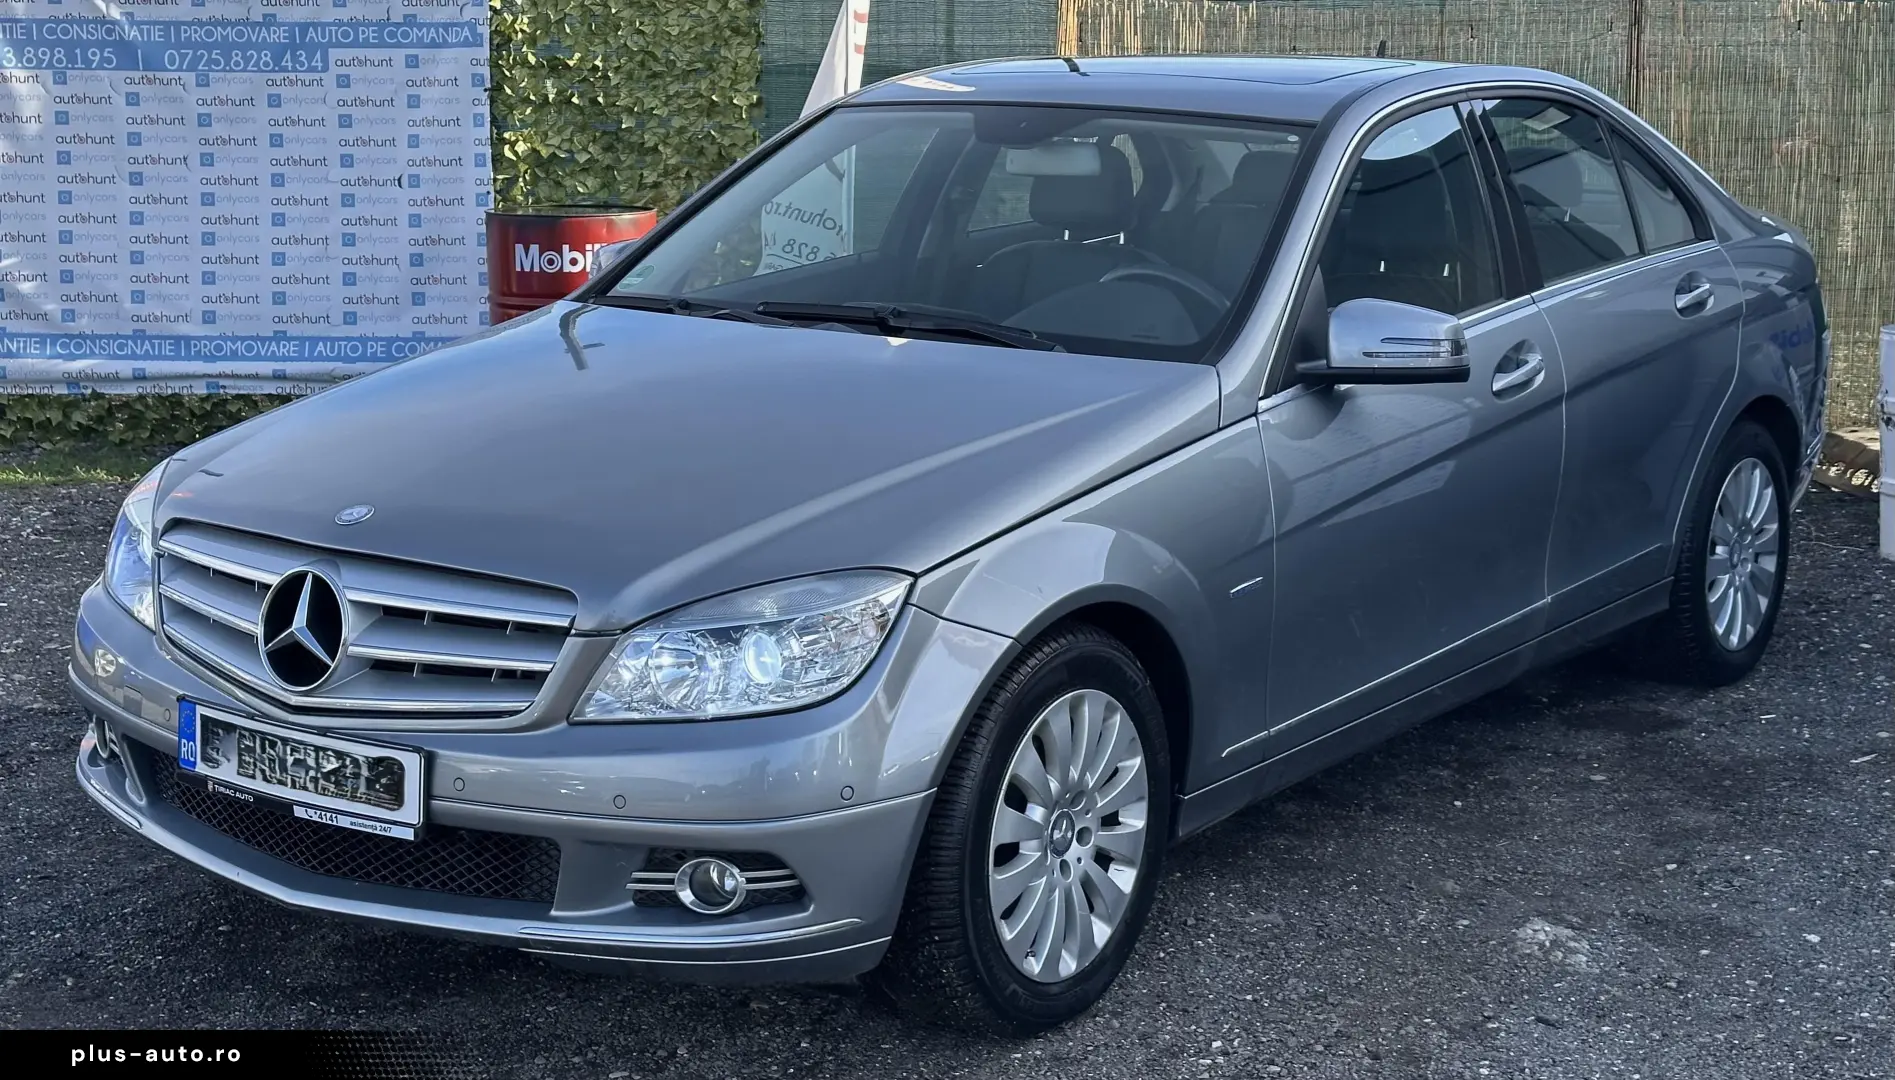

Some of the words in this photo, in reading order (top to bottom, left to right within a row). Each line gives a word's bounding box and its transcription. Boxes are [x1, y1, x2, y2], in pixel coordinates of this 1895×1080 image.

[42, 23, 164, 41] CONSIGNATIE
[181, 25, 289, 43] PROMOVARE
[305, 26, 354, 43] AUTO
[359, 26, 379, 43] PE
[383, 26, 473, 43] COMANDA
[3, 46, 117, 69] 3.898.195
[164, 49, 323, 71] 0725.828.434
[335, 55, 393, 68] autohunt
[124, 74, 183, 87] autohunt
[265, 75, 324, 88] autohunt
[406, 75, 459, 88] autohunt
[53, 94, 112, 105] autohunt
[196, 94, 255, 107] autohunt
[337, 95, 395, 108] autohunt
[126, 114, 186, 126] autohunt
[268, 114, 326, 127] autohunt
[407, 115, 461, 128] autohunt
[55, 133, 115, 145] autohunt
[199, 134, 257, 147] autohunt
[339, 136, 397, 148] autohunt
[127, 153, 187, 166] autohunt
[270, 154, 328, 167] autohunt
[407, 155, 463, 167] autohunt
[57, 173, 116, 185] autohunt
[200, 174, 259, 186] autohunt
[340, 174, 398, 187] autohunt
[129, 193, 188, 206] autohunt
[271, 194, 329, 207] autohunt
[408, 195, 465, 207] autohunt
[57, 212, 117, 224] autohunt
[200, 214, 260, 226] autohunt
[341, 214, 398, 227] autohunt
[129, 233, 189, 245] autohunt
[271, 233, 330, 246] autohunt
[408, 235, 466, 247] autohunt
[59, 252, 118, 264] autohunt
[201, 253, 259, 265] autohunt
[342, 254, 399, 266] autohunt
[130, 272, 190, 284] autohunt
[271, 273, 330, 285] autohunt
[410, 274, 467, 286] autohunt
[60, 291, 119, 303] autohunt
[201, 292, 260, 304] autohunt
[342, 293, 399, 306] autohunt
[131, 312, 190, 324] autohunt
[272, 312, 331, 325] autohunt
[412, 313, 468, 325] autohunt
[56, 338, 175, 356] CONSIGNATIE
[190, 340, 299, 357] PROMOVARE
[313, 341, 363, 357] AUTO
[367, 341, 387, 357] PE
[181, 738, 196, 761] RO
[235, 792, 254, 802] AUTO
[378, 826, 392, 834] 24/7
